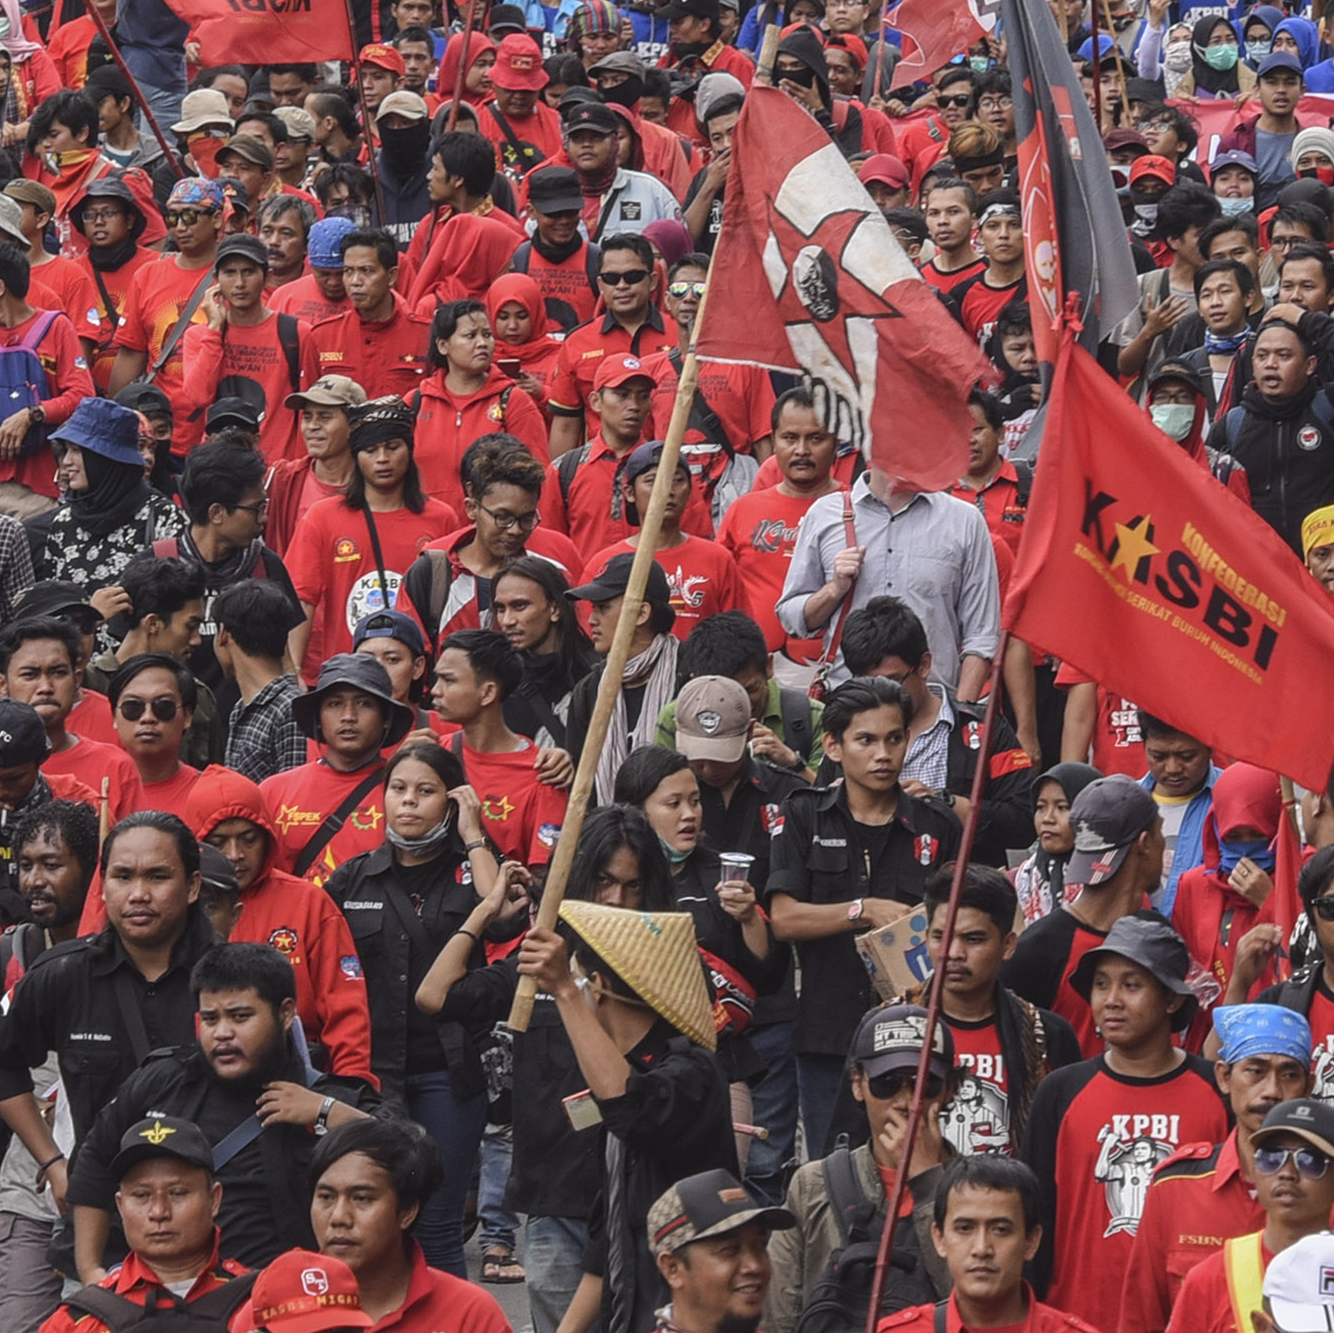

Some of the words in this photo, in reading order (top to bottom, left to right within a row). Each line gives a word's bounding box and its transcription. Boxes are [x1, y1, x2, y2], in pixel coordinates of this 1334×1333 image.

[1182, 521, 1286, 626] KONFEDERASI
[1127, 588, 1172, 622] SERIKAT
[1172, 614, 1209, 644] BURUH
[958, 1054, 1003, 1082] PBI
[1112, 1115, 1179, 1144] KPBI
[1179, 1235, 1223, 1246] FSBN
